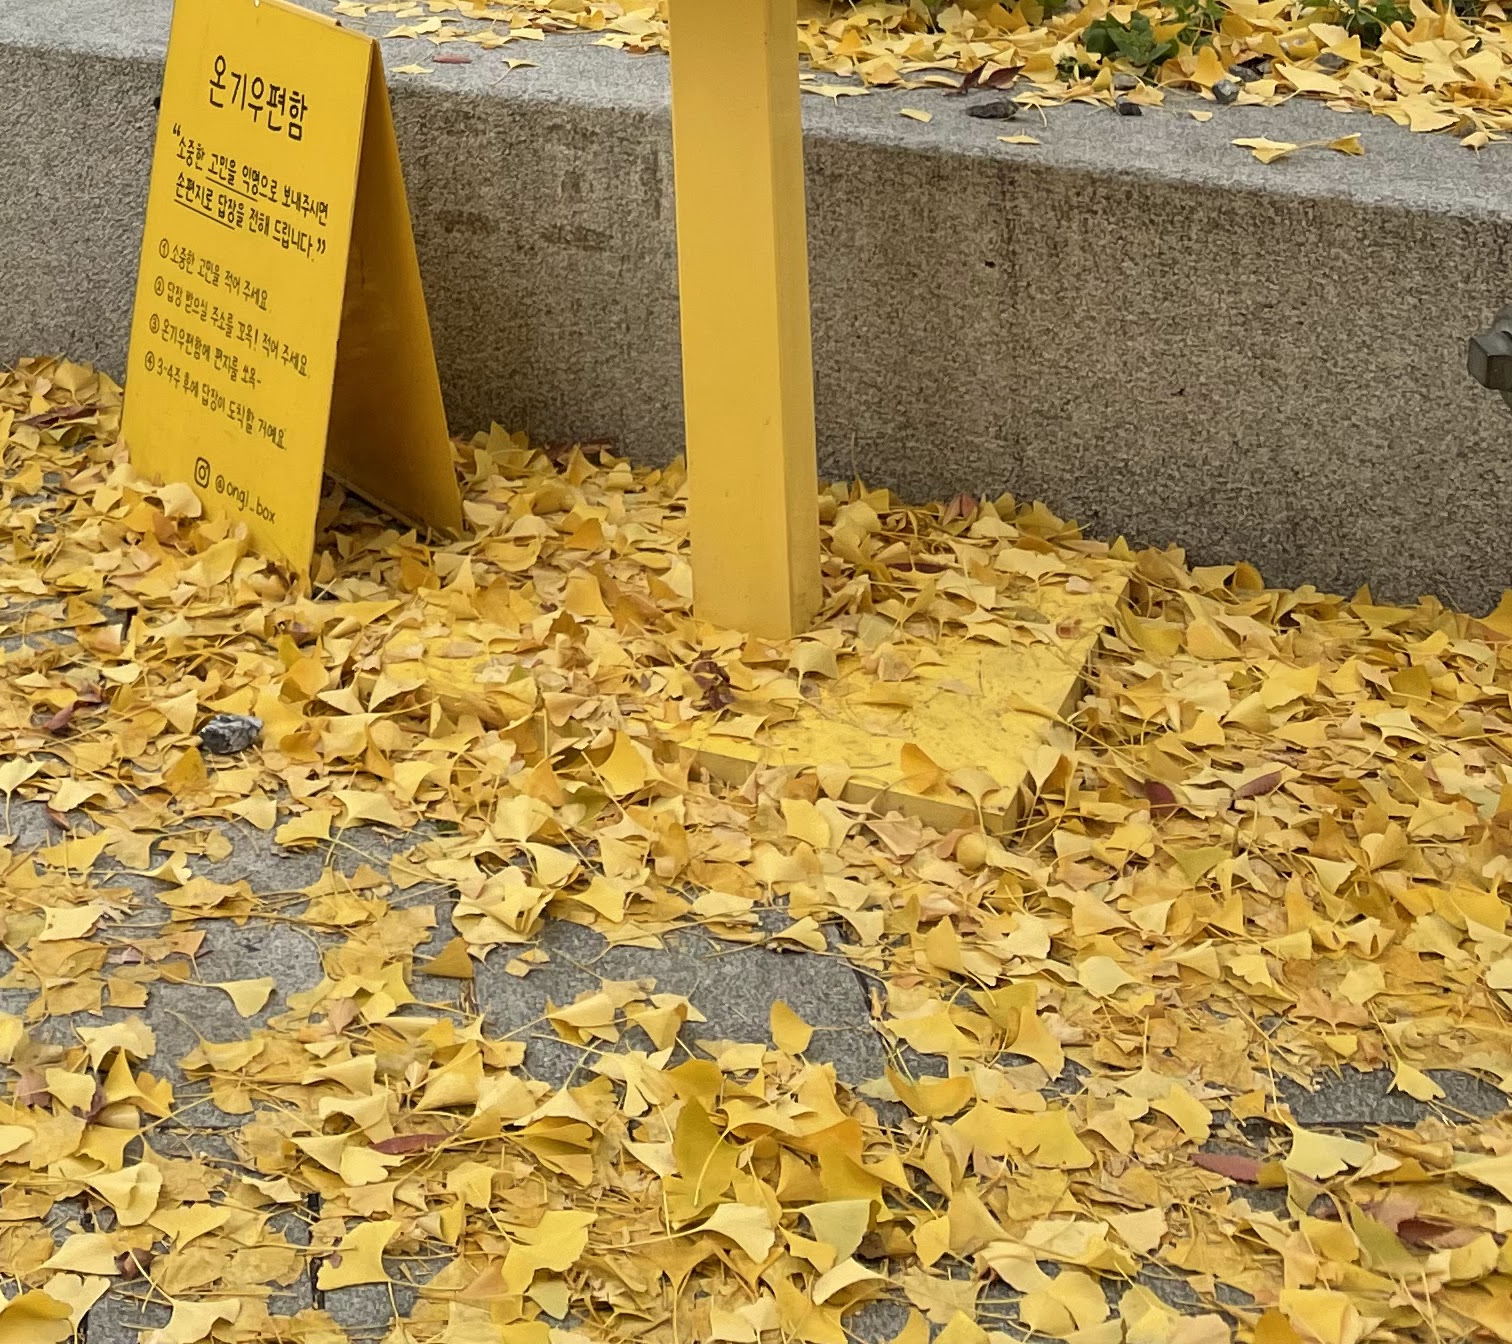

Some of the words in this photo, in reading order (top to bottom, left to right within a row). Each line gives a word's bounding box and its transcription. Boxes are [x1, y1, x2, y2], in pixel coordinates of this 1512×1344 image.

[209, 54, 309, 141] 온기우편함
[175, 171, 214, 212] 손편지로
[217, 194, 245, 229] 답장을
[248, 208, 270, 237] 전해
[207, 152, 238, 187] 고민을
[241, 165, 279, 204] 익명으로
[281, 184, 329, 227] 보내주시면
[170, 244, 196, 275] 소중한
[197, 258, 221, 288] 고민을
[224, 270, 241, 296] 적어
[161, 318, 211, 362] 온기우편함에
[213, 347, 238, 382] 편지를
[167, 281, 183, 308] 답장
[185, 290, 209, 323] 받으실
[210, 306, 234, 339] 주소를
[262, 332, 279, 360] 적어
[182, 371, 199, 399] 후에
[201, 383, 226, 412] 답장이
[227, 400, 255, 435] 도착할
